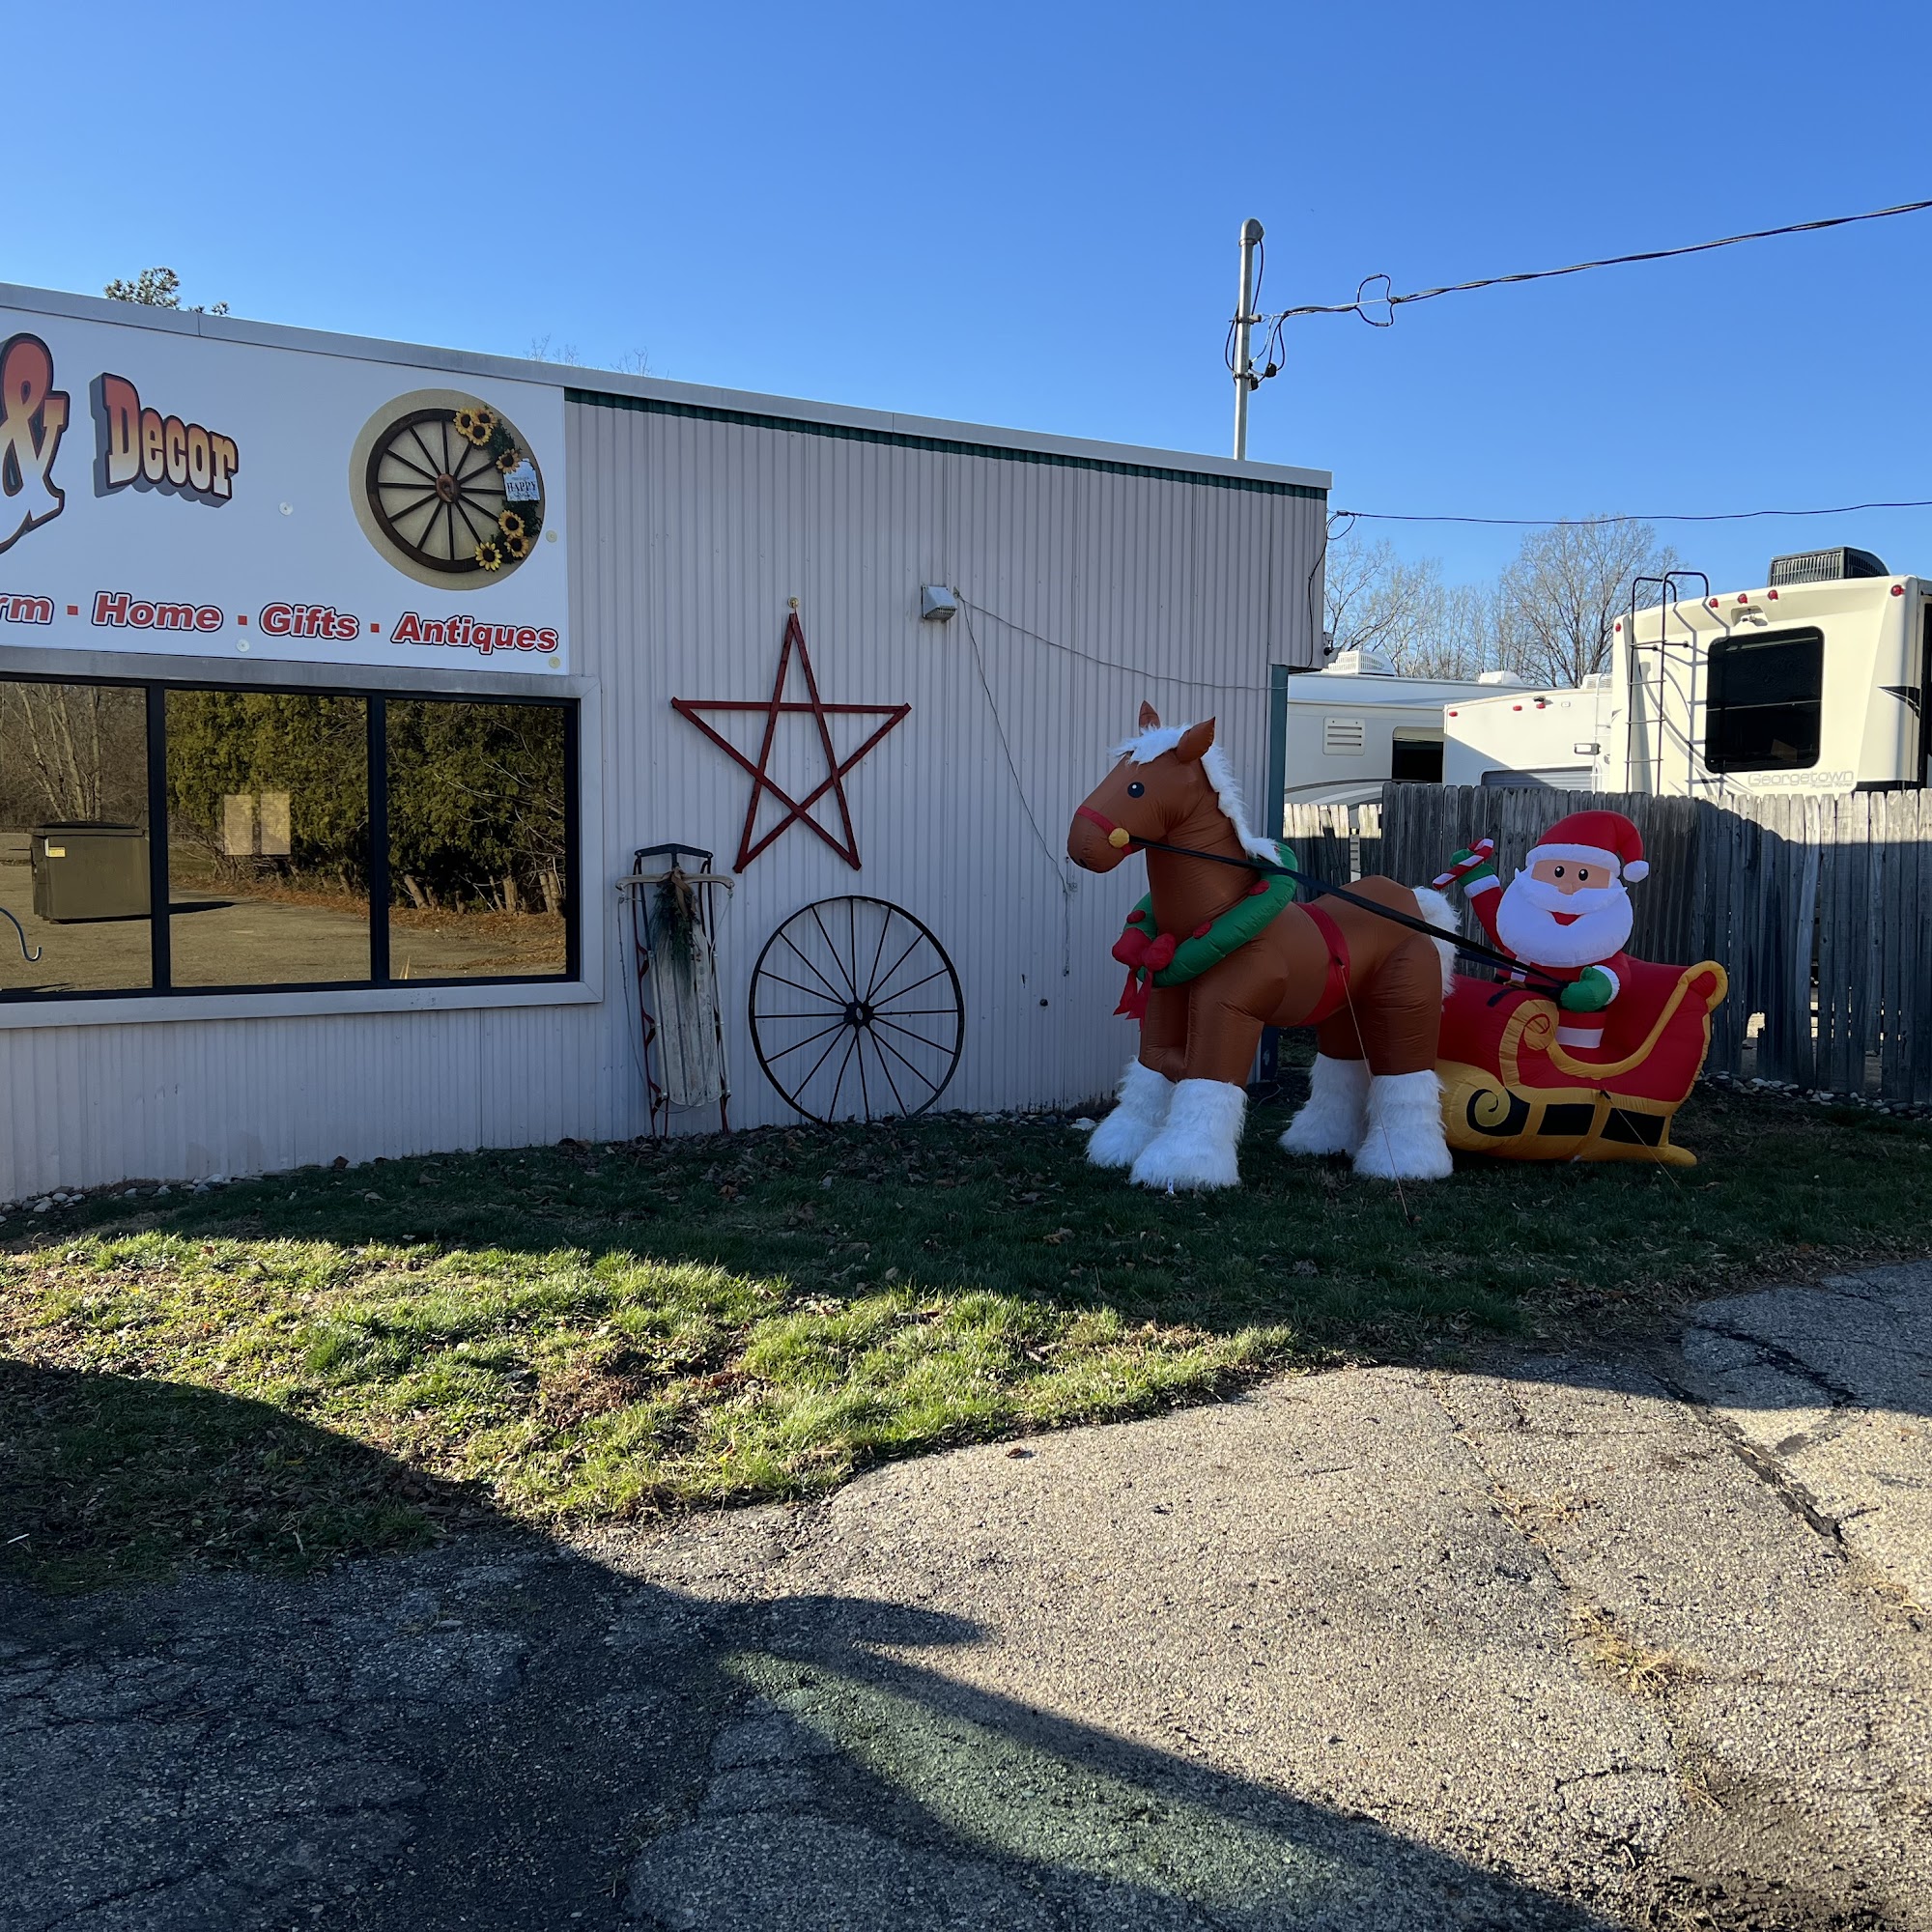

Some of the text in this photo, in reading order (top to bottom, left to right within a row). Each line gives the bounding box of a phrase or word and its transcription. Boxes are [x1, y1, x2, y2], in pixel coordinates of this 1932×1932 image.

[98, 372, 239, 500] Decor
[92, 590, 223, 632] Home
[259, 602, 359, 640] Gifts
[390, 611, 558, 655] Antiques
[1747, 770, 1854, 785] Georgetown
